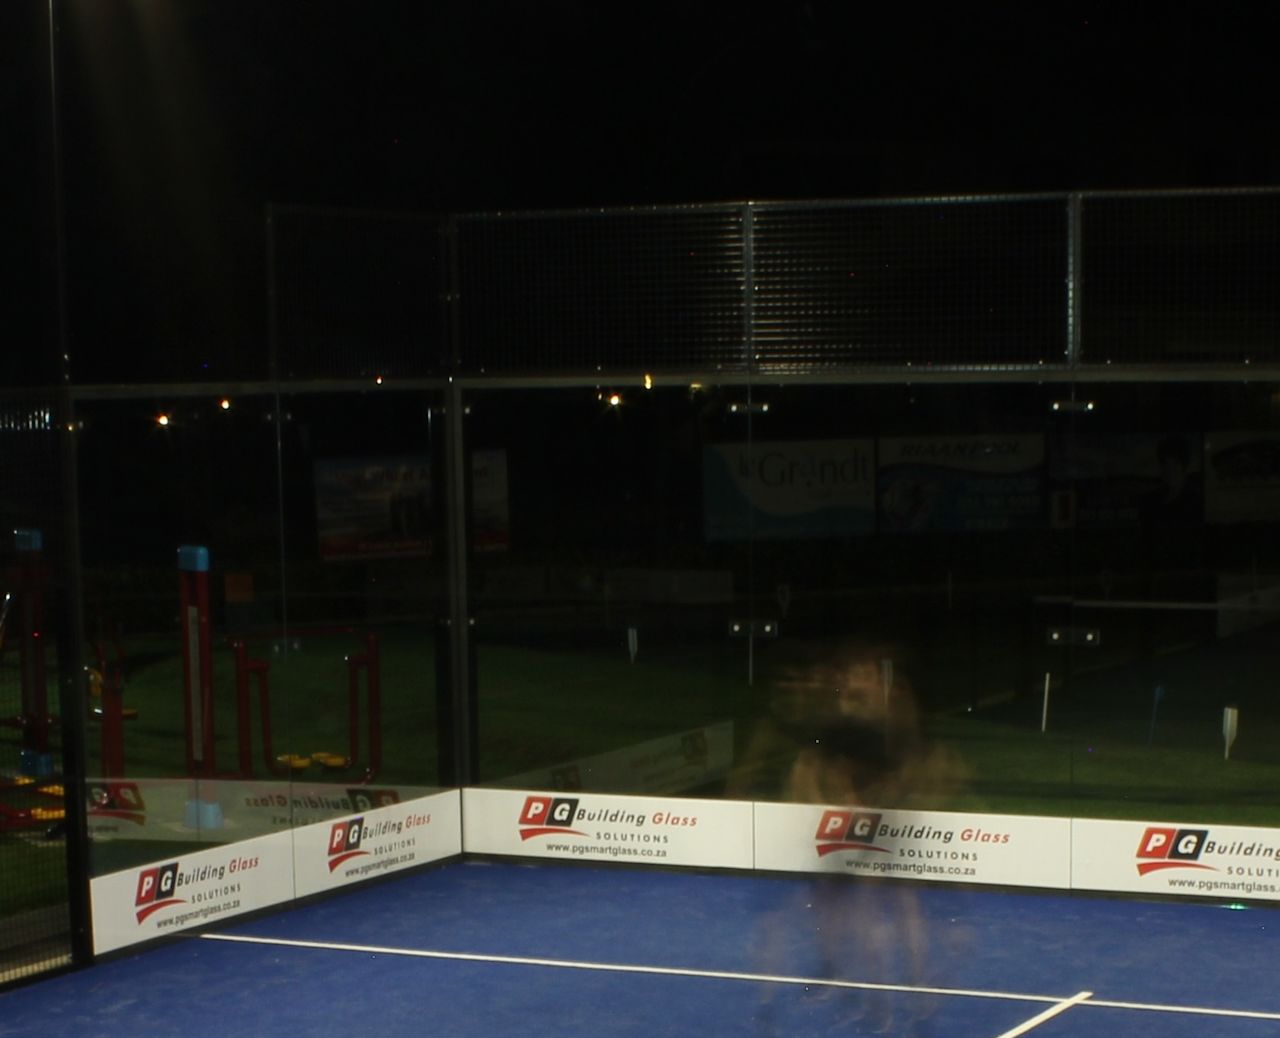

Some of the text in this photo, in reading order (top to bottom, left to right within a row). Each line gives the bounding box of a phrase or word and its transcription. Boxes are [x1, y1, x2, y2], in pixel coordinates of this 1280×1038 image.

[525, 800, 698, 828] PG Building Glass
[330, 820, 362, 850] PG
[362, 819, 403, 842] Building
[405, 812, 432, 830] Glass
[596, 831, 669, 844] SOLUTIONS
[822, 814, 1011, 844] PG Building Glass
[374, 837, 417, 857] SOLUTIONS
[546, 841, 667, 858] www.pgsmartglass.co.za
[899, 848, 979, 862] SOLUTIONS
[1145, 832, 1200, 857] PG
[139, 855, 260, 898] PG Building Glass
[345, 852, 416, 878] www.pgsmartglass.co.za
[845, 858, 977, 876] www.pgsmartglass.co.za
[191, 882, 242, 905] SOLUTIONS
[156, 898, 241, 929] www.pgsmartglass.co.za
